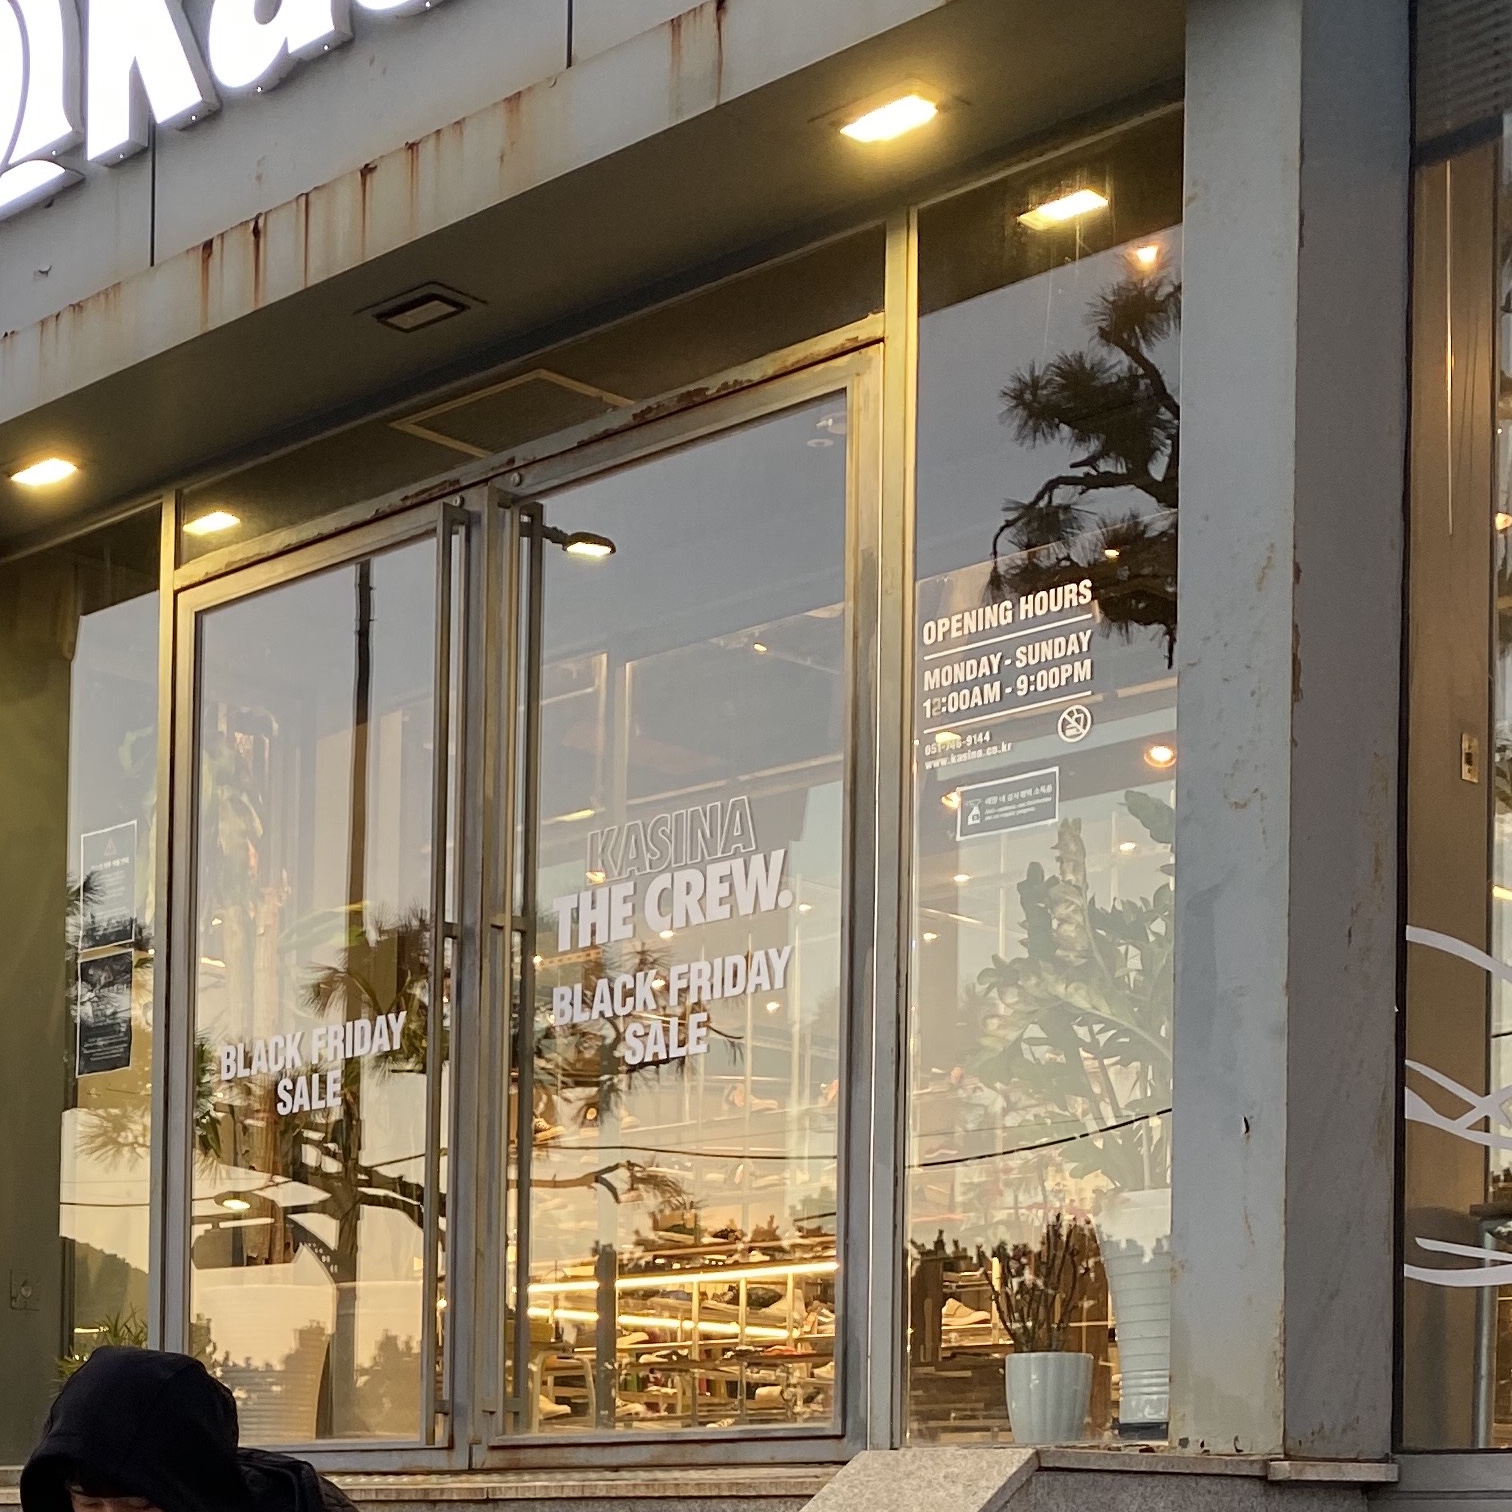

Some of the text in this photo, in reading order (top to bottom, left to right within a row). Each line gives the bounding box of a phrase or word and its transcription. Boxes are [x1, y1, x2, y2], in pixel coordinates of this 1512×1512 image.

[923, 579, 1092, 645] OPENING HOURS
[924, 652, 1002, 691] MONDAY
[1016, 629, 1092, 668] SUNDAY
[1016, 659, 1092, 696] 9:00PM
[587, 795, 756, 885] KASINA
[553, 849, 793, 952] THE CREW.
[553, 945, 792, 1027] BLACK FRIDAY
[221, 1011, 407, 1080] BLACK FRIDAY
[625, 1012, 708, 1065] SALE
[277, 1070, 342, 1116] SALE
